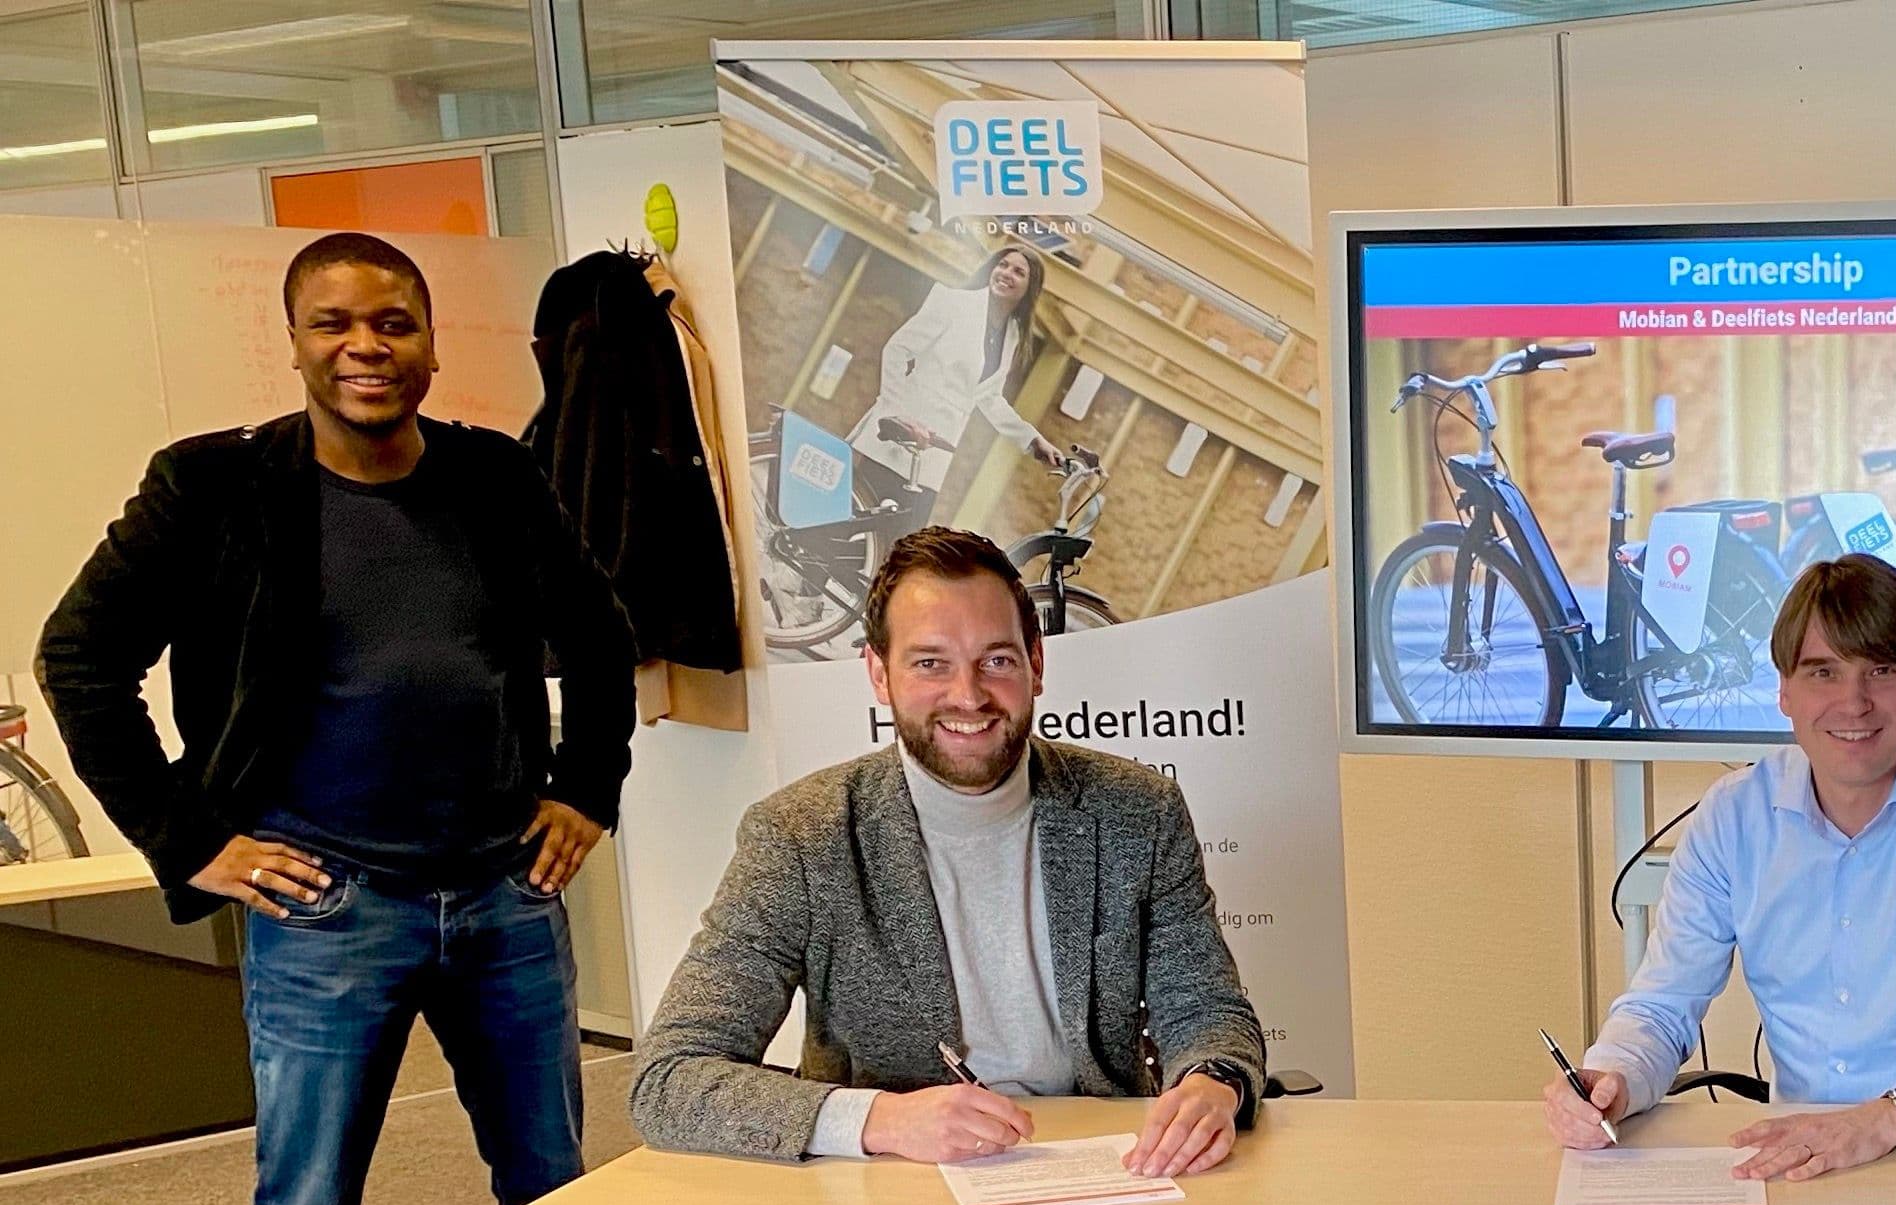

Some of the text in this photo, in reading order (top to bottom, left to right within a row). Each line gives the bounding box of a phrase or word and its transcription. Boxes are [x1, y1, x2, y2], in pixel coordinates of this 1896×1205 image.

[949, 119, 1083, 156] DEEL
[952, 159, 1088, 197] FIETS
[954, 221, 1093, 235] NEDERLAND
[1669, 252, 1864, 292] Partnership
[1619, 309, 1688, 328] Mobian
[1692, 309, 1706, 328] &
[1711, 307, 1796, 328] Deelfiets
[1848, 520, 1886, 544] DEEL
[1038, 698, 1246, 740] ederland!
[1218, 838, 1239, 853] de
[1247, 912, 1273, 926] om
